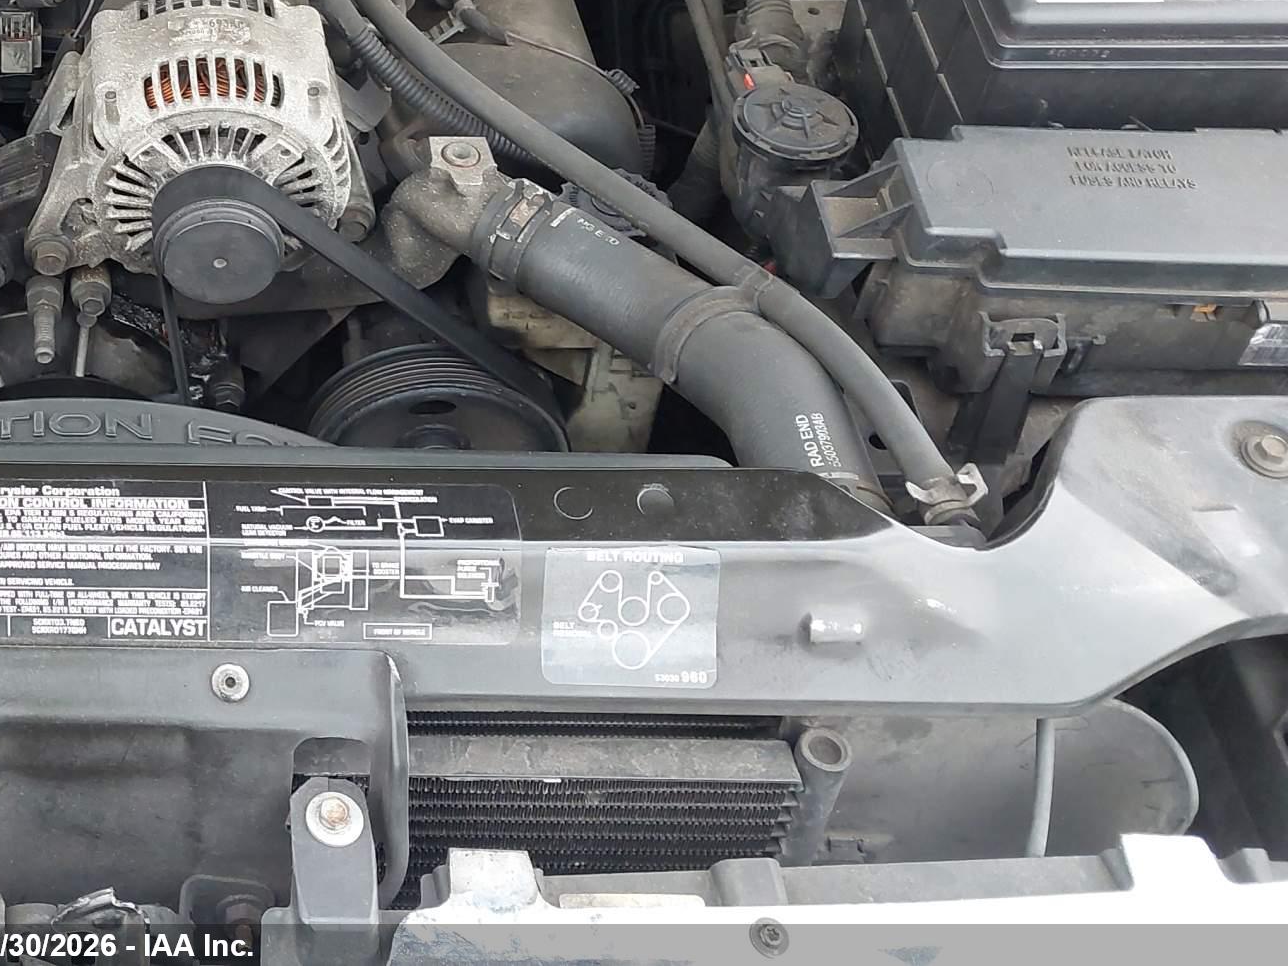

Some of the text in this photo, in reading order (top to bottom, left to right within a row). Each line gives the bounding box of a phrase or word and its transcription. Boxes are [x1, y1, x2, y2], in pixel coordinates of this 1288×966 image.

[795, 414, 825, 467] RAD END
[41, 485, 120, 499] Corporation
[23, 497, 87, 508] CONTROL
[91, 497, 189, 509] INFORMATION
[586, 551, 684, 563] BELT ROUTING
[111, 619, 207, 636] CATALYST
